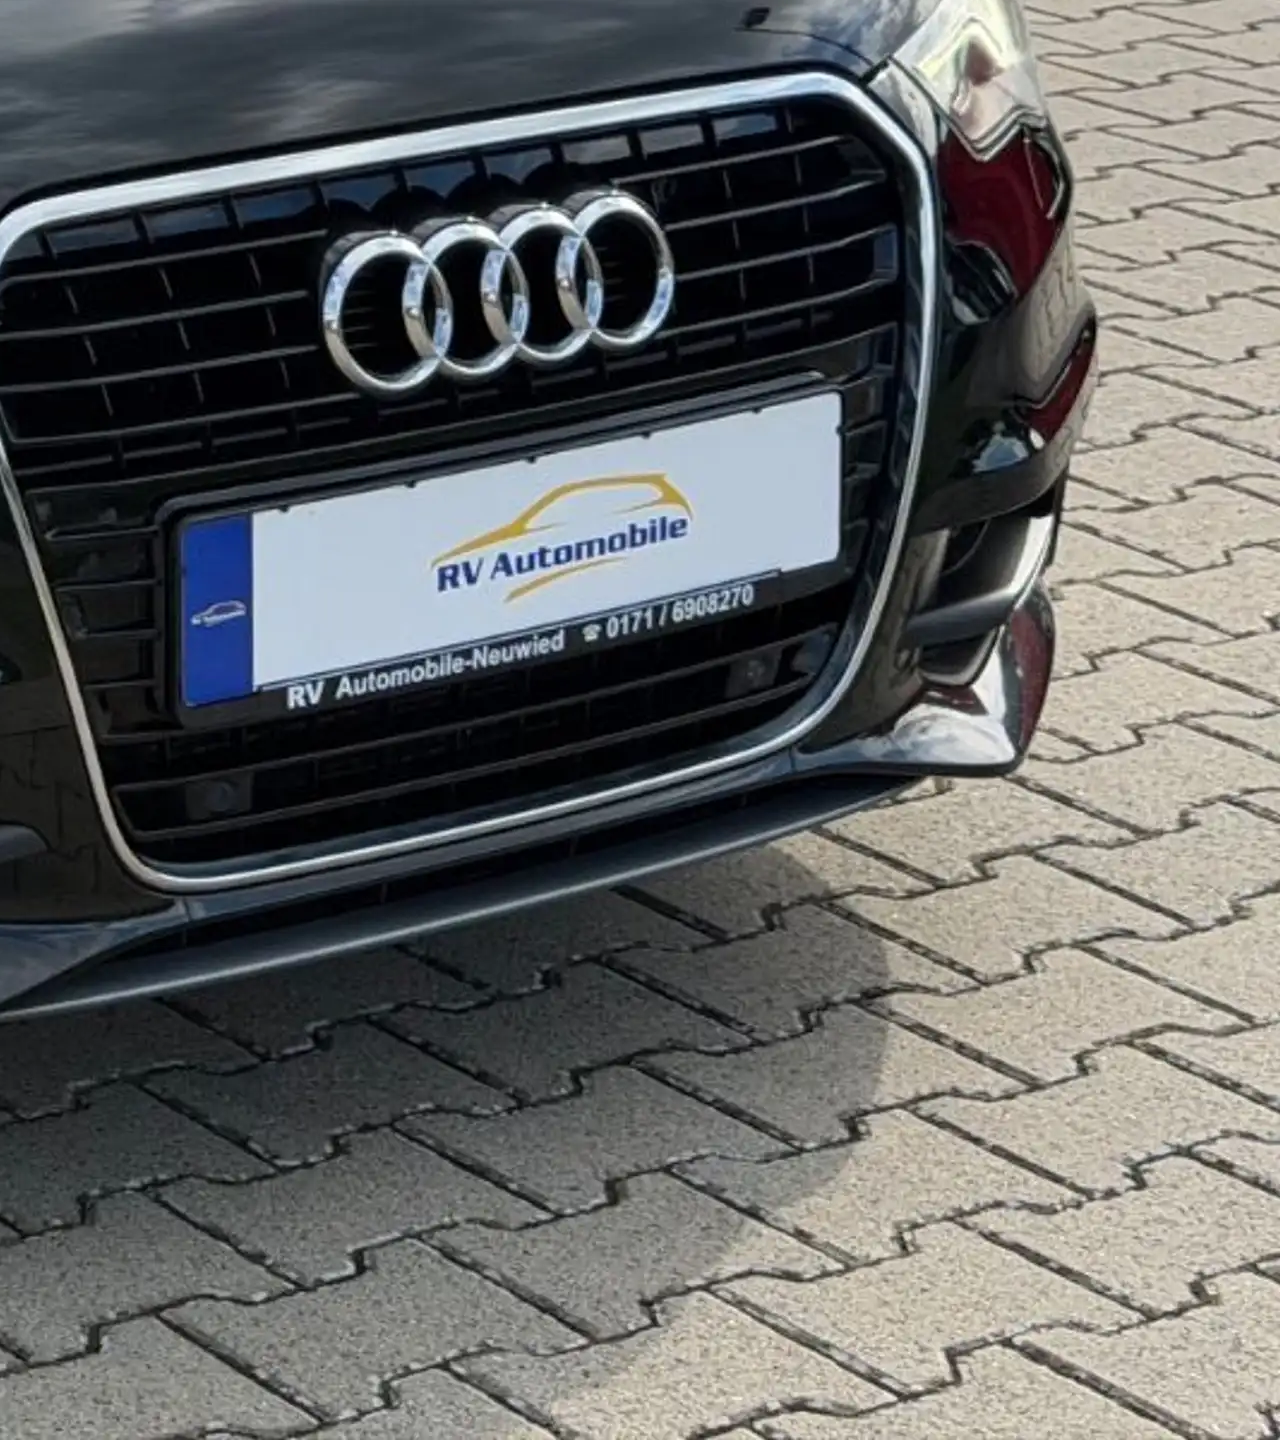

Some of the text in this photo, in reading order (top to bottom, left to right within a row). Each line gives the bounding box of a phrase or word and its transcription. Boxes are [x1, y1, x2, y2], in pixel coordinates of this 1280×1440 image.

[437, 516, 688, 592] RV Automobile
[287, 583, 755, 710] RV Automobile-Neuwied 0171 / 6908270
